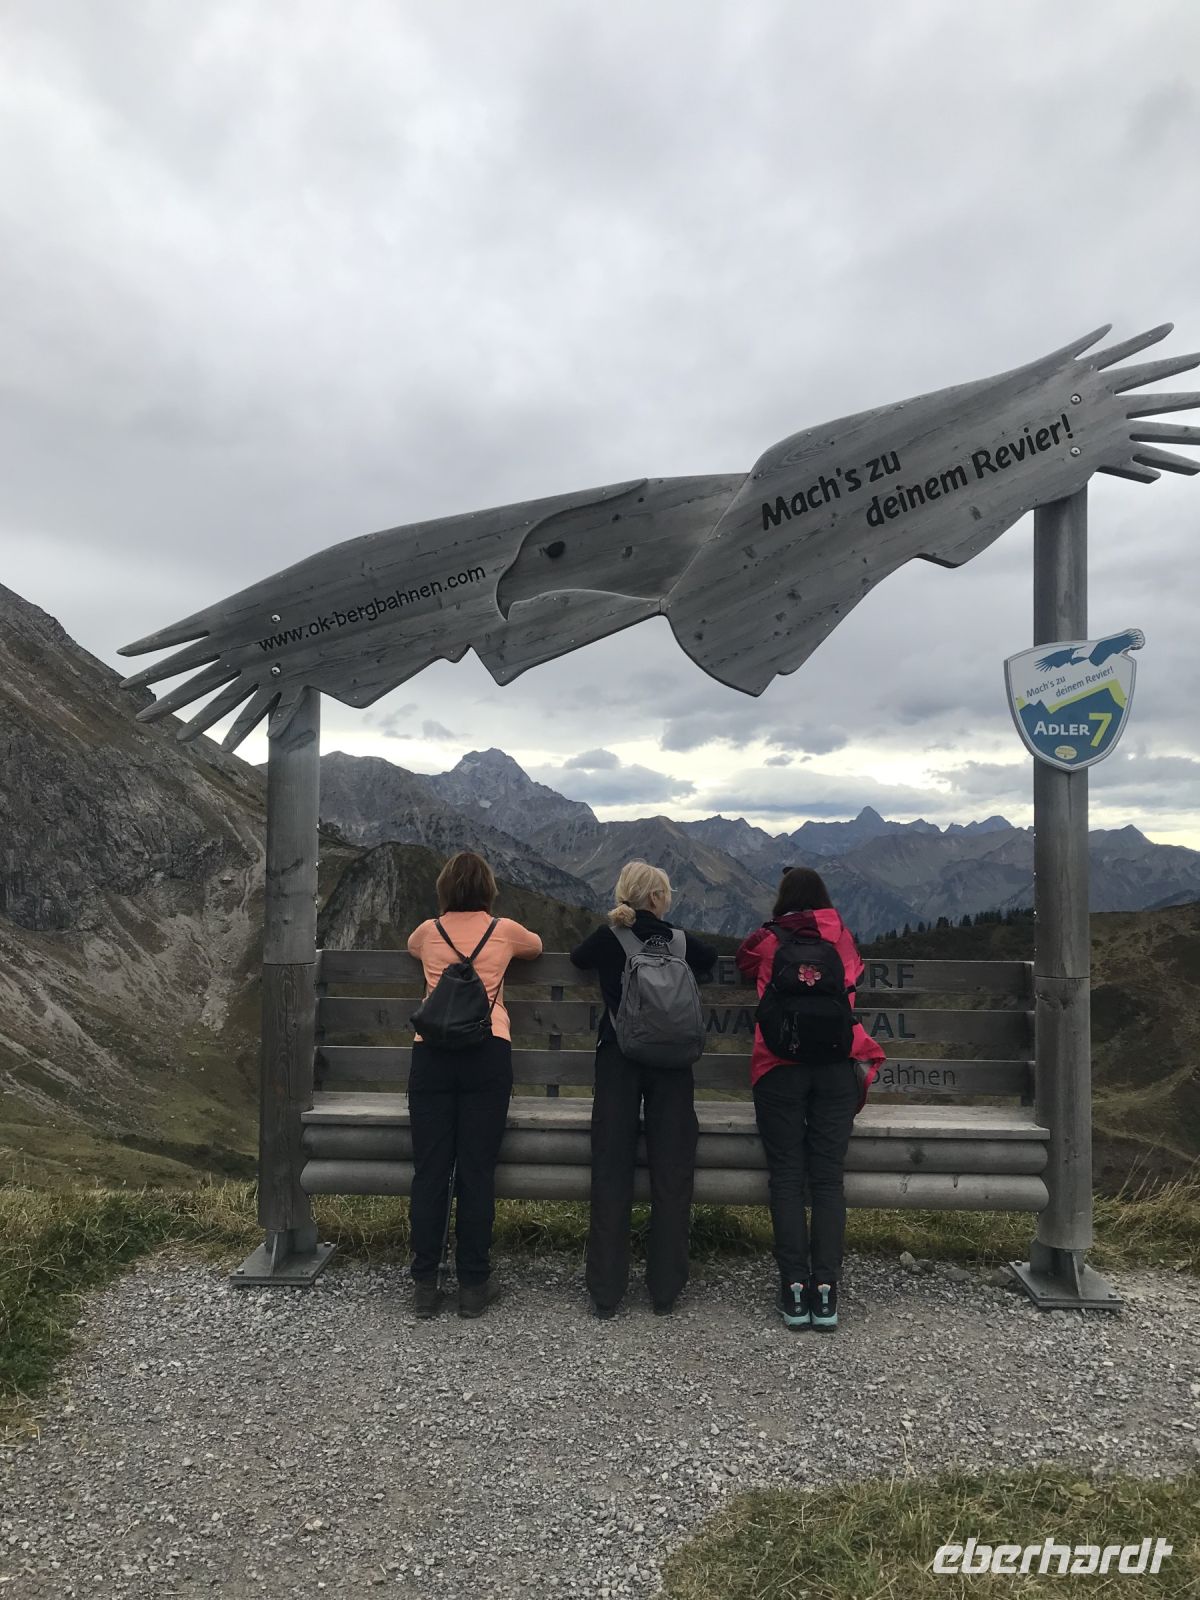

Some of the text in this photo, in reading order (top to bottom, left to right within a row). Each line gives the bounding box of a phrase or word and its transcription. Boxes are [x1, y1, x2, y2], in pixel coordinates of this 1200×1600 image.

[762, 451, 901, 531] Mach's zu
[866, 413, 1074, 527] deinem Revier!
[258, 566, 486, 651] www.ok-bergbahnen.com
[1026, 676, 1066, 698] Mach's zu
[1055, 666, 1114, 697] deinem Revier!
[1033, 713, 1112, 748] ADLER 7
